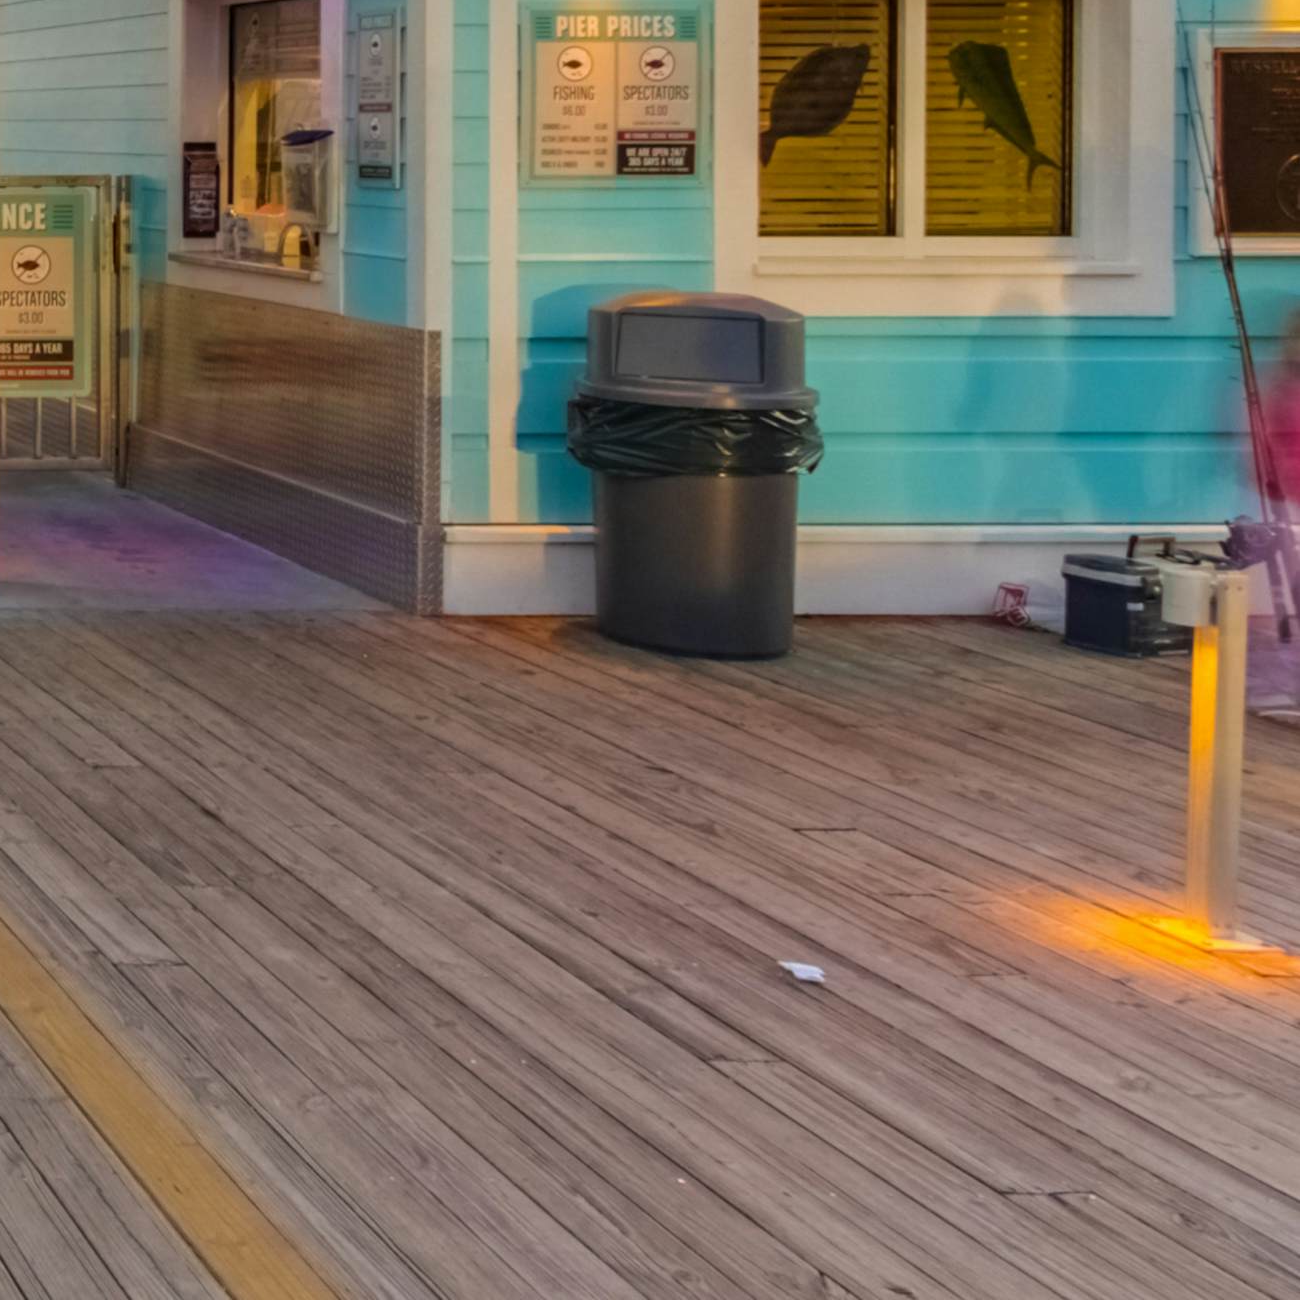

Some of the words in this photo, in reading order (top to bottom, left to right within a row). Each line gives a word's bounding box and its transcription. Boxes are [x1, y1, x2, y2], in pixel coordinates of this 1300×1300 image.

[556, 15, 599, 38] PIER
[606, 15, 675, 38] PRICES
[553, 85, 594, 100] FISHING
[623, 85, 689, 100] SPECTATORS
[18, 311, 44, 324] $3.00
[13, 343, 33, 354] DAYS
[35, 343, 41, 354] A
[42, 343, 63, 354] YEAR
